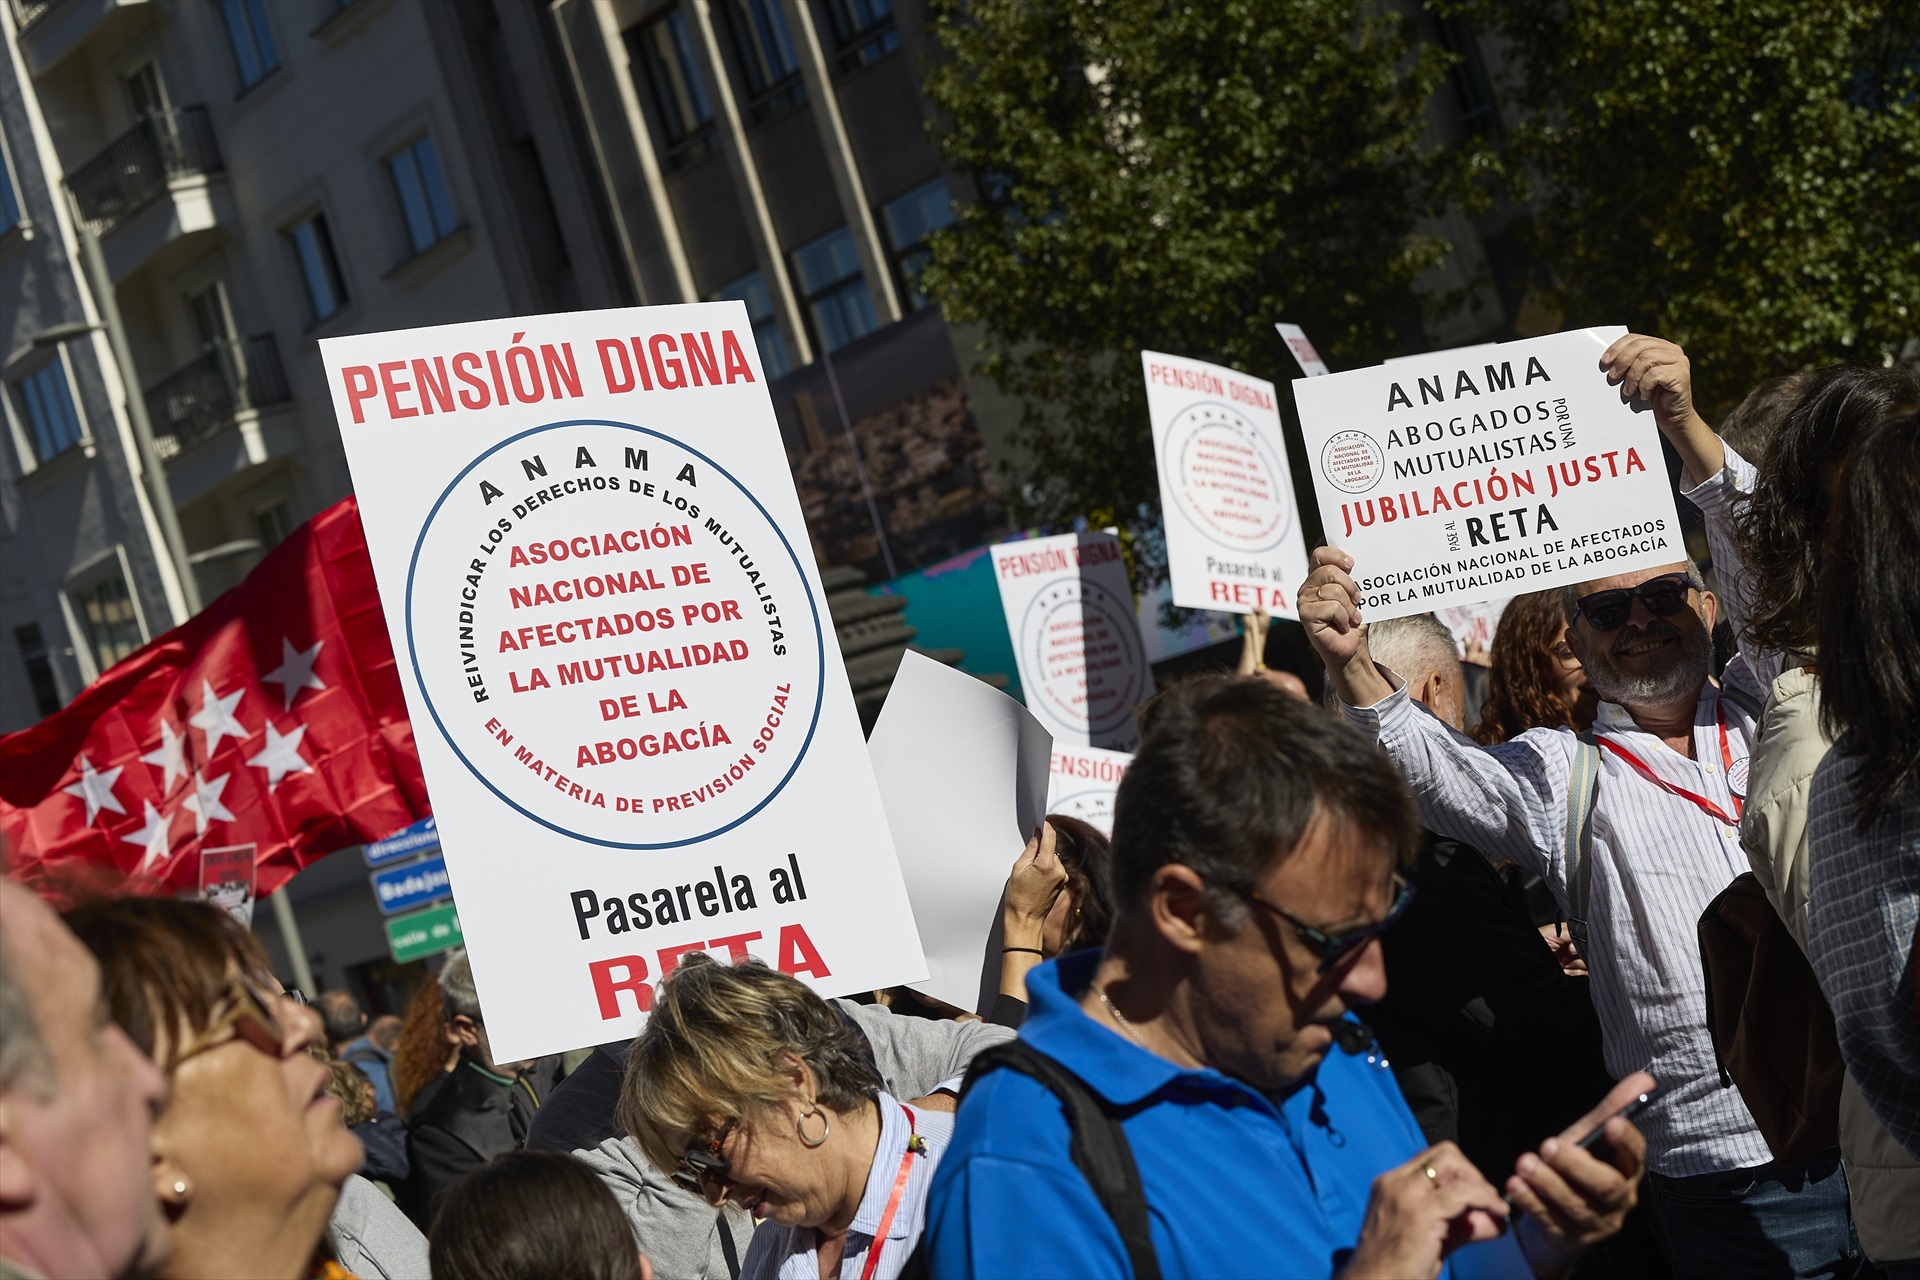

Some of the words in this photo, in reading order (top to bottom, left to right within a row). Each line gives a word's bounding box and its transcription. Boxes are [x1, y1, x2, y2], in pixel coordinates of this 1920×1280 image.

[341, 331, 584, 424] PENSIÓN
[596, 329, 756, 395] DIGNA
[1150, 364, 1224, 396] PENSIÓN
[1228, 380, 1274, 411] DIGNA
[1388, 356, 1551, 412] ANAMA
[1387, 401, 1550, 449] ABOGADOS
[1553, 398, 1569, 422] POR
[1334, 443, 1365, 453] ASOCIACIÓN
[1394, 431, 1557, 480] MUTUALISTAS
[1559, 423, 1577, 449] UNA
[478, 445, 699, 506] ANAMA
[1332, 457, 1360, 466] AFECTADOS
[1341, 467, 1536, 537] JUBILACIÓN
[1547, 447, 1646, 498] JUSTA
[509, 522, 693, 568] ASOCIACIÓN
[1445, 520, 1455, 530] AL
[1447, 532, 1460, 552] PASE
[1457, 546, 1539, 572] NACIONAL
[1544, 540, 1565, 555] DE
[1570, 519, 1666, 550] AFECTADOS
[1466, 503, 1559, 547] RETA
[509, 569, 665, 608] NACIONAL
[671, 562, 711, 588] DE
[999, 545, 1068, 579] PENSIÓN
[1206, 556, 1266, 579] Pasarela
[1357, 594, 1392, 610] POR
[1397, 589, 1418, 603] LA
[1423, 567, 1526, 596] MUTUALIDAD
[1532, 563, 1552, 578] DE
[1557, 556, 1579, 571] LA
[1583, 536, 1668, 565] ABOGACÍA
[459, 558, 489, 703] REIVINDICAR
[487, 518, 513, 555] LOS
[512, 476, 620, 520] DERECHOS
[629, 479, 655, 498] DE
[663, 490, 701, 519] LOS
[704, 517, 787, 656] MUTUALISTAS
[1210, 581, 1287, 610] RETA
[499, 607, 675, 653] AFECTADOS
[682, 599, 743, 626] POR
[508, 668, 551, 693] LA
[557, 639, 750, 685] MUTUALIDAD
[599, 695, 641, 721] DE
[647, 689, 688, 714] LA
[485, 717, 514, 747] EN
[514, 745, 606, 809] MATERIA
[616, 796, 644, 813] DE
[653, 752, 756, 814] PREVISIÓN
[752, 681, 791, 754] SOCIAL
[575, 721, 732, 768] ABOGACÍA
[1050, 753, 1127, 784] ENSIÓN
[570, 865, 758, 940] Pasarela
[768, 853, 808, 906] al
